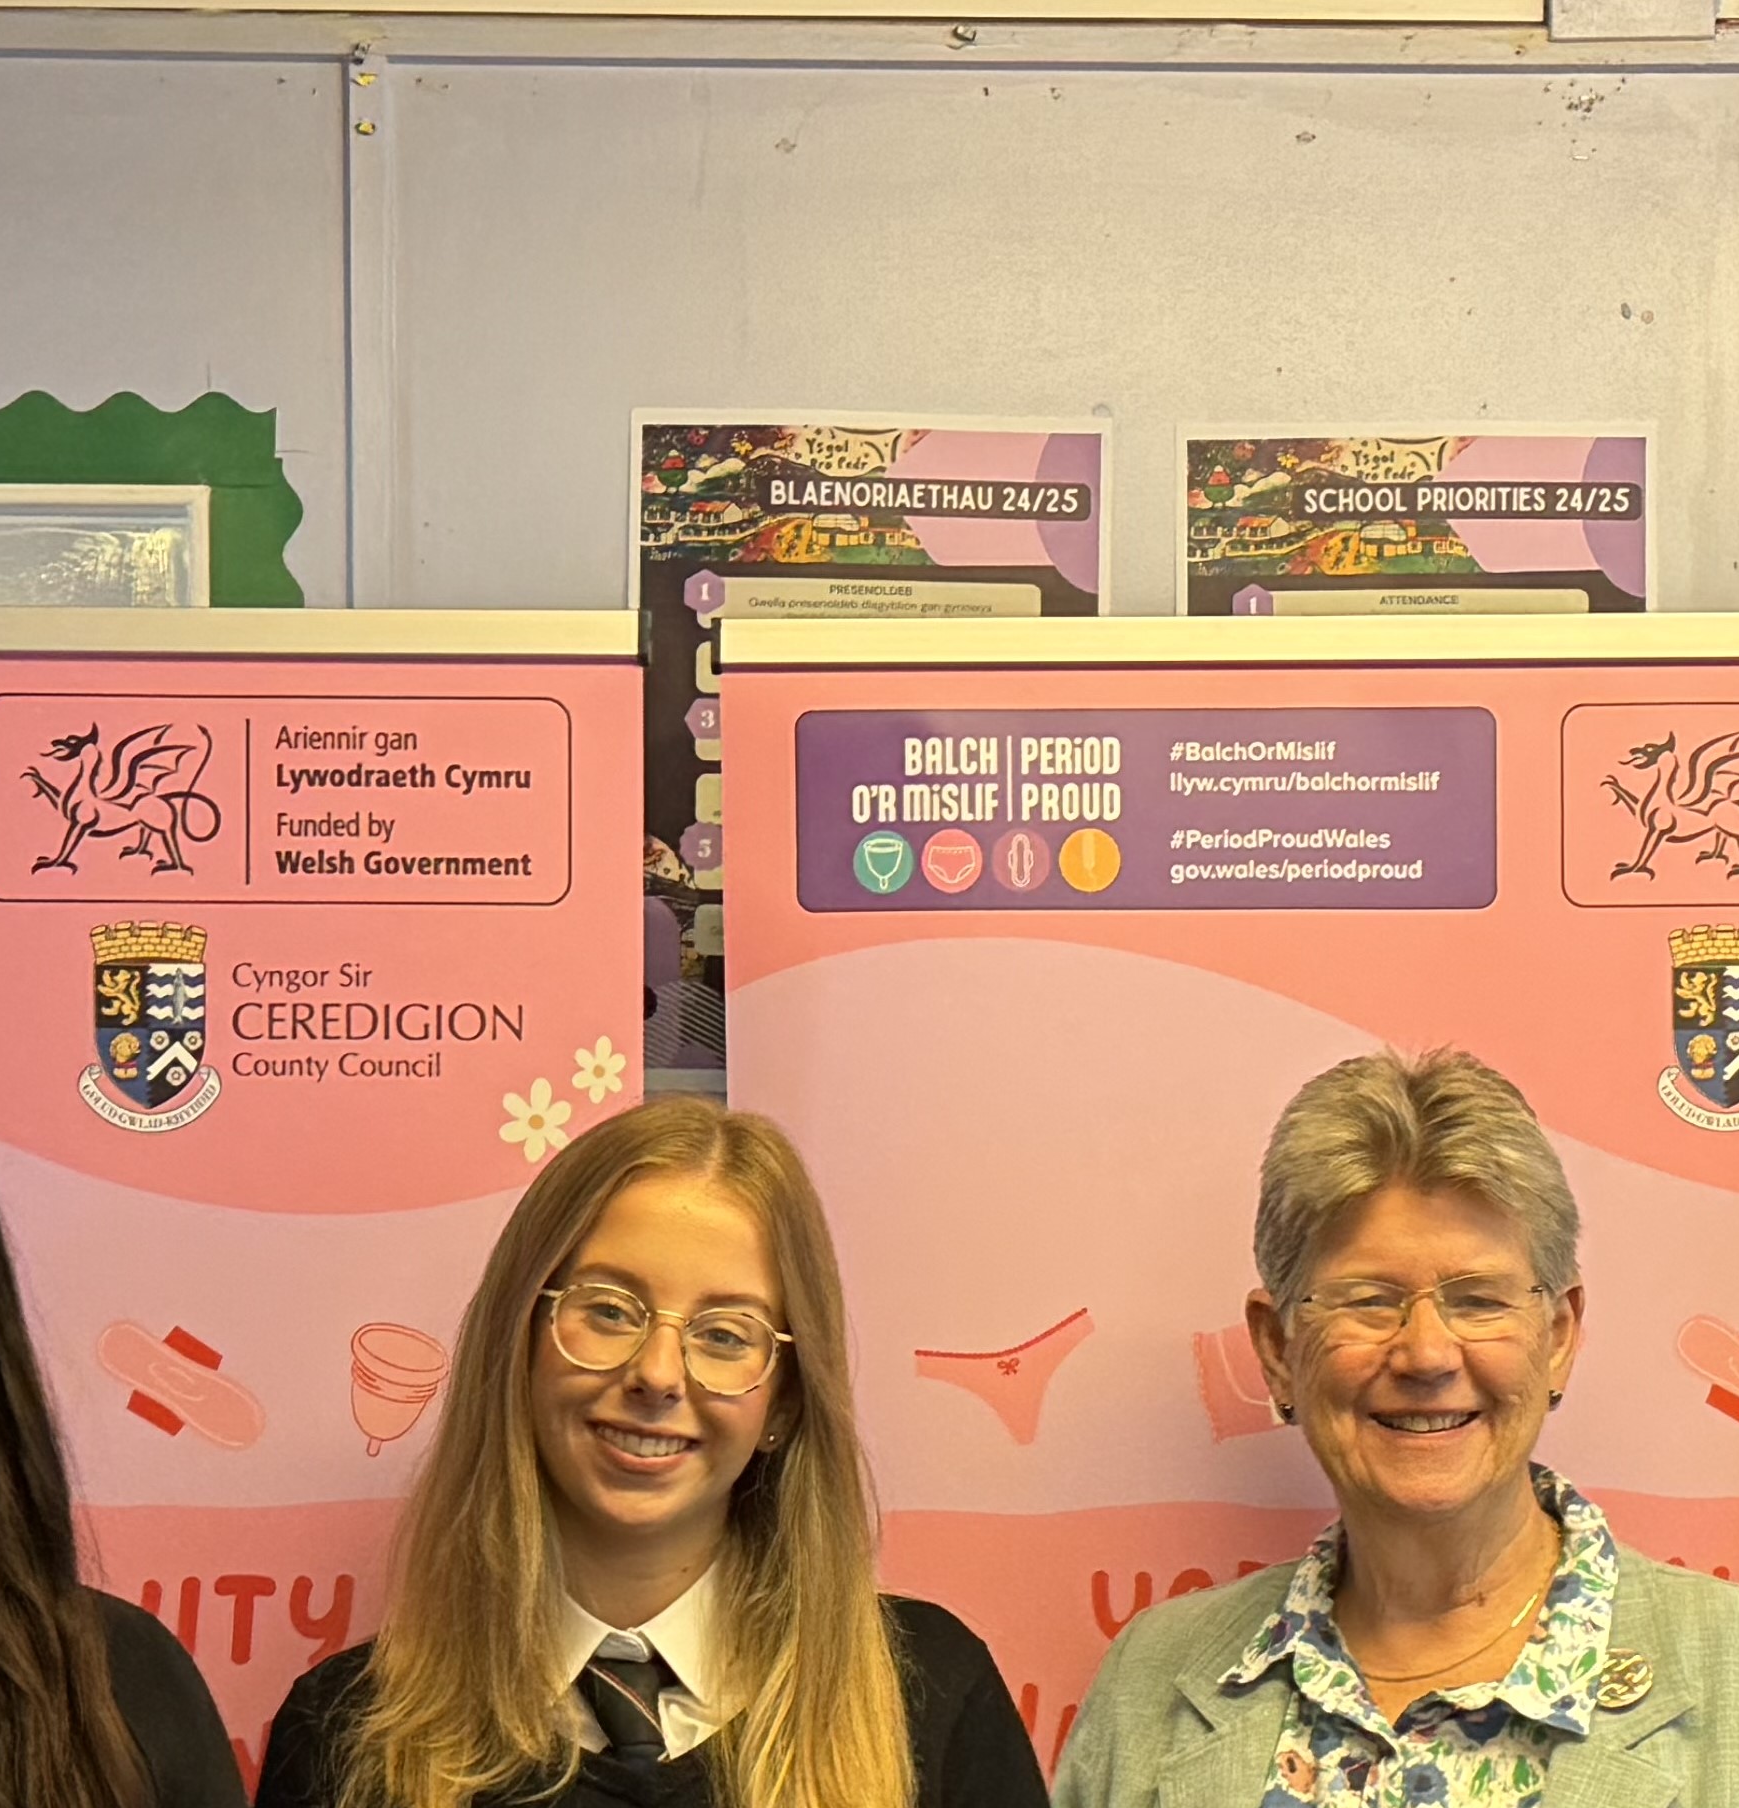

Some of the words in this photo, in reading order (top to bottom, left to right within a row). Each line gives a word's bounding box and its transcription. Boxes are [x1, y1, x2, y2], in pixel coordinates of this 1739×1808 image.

[770, 479, 993, 511] BLAENORIAETHAU
[1003, 487, 1078, 512] 24/25
[1305, 488, 1407, 513] SCHOOL
[1417, 487, 1545, 511] PRIORITIES
[1556, 488, 1629, 512] 24/25
[701, 583, 709, 600] 1
[1380, 595, 1459, 606] ATTENDANCE
[701, 710, 714, 728] 3
[275, 725, 367, 750] Ariennir
[375, 732, 417, 756] gan
[1170, 741, 1336, 761] #BalchOrMislif
[905, 737, 998, 775] BALCH
[277, 763, 435, 794] Lywodraeth
[445, 764, 530, 795] Cymru
[1171, 771, 1440, 796] llyw.cymru/balchormislif
[1022, 783, 1120, 821] PROUD
[277, 812, 359, 837] Funded
[369, 812, 395, 843] by
[1171, 829, 1390, 849] #PeriodProudWales
[698, 839, 711, 857] 5
[276, 850, 354, 874] Welsh
[364, 851, 531, 875] Government
[1171, 859, 1422, 883] gov.wales/periodproud
[232, 963, 329, 993] Cyngor
[340, 963, 372, 987] Sir
[232, 1003, 522, 1041] CEREDIGION
[233, 1052, 328, 1082] County
[339, 1052, 440, 1077] Council
